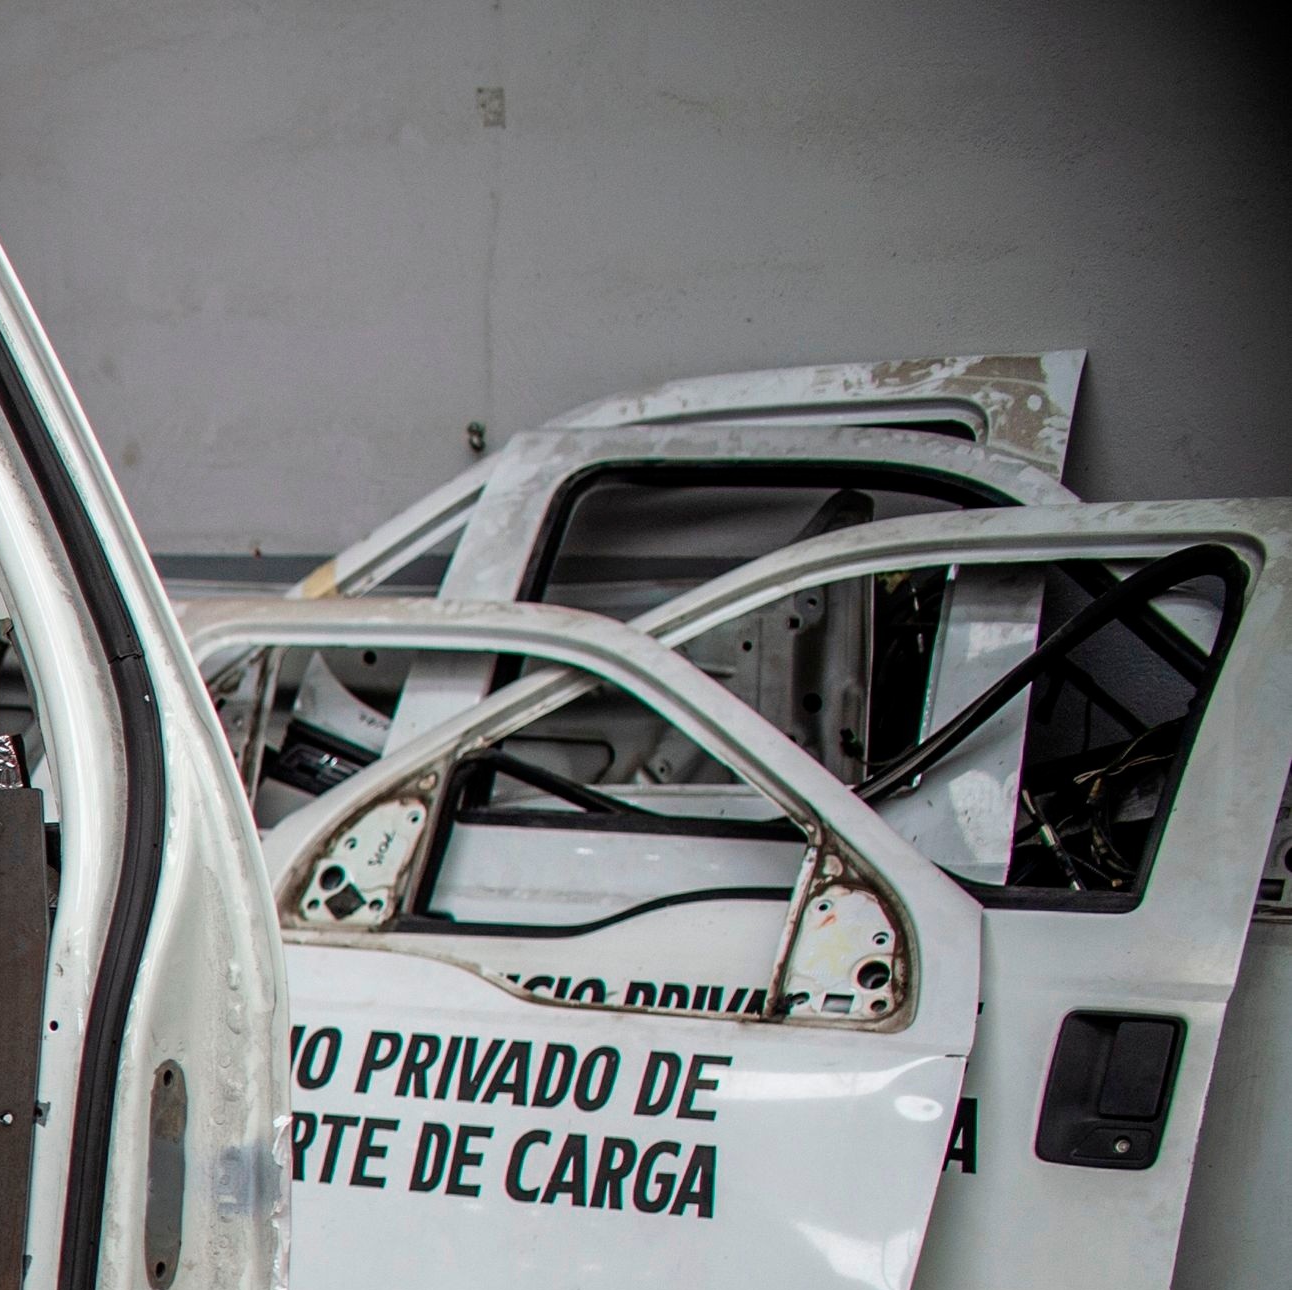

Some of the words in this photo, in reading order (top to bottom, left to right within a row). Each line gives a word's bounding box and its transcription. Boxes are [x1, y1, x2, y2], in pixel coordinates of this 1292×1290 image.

[354, 1029, 621, 1112] PRIVADO
[633, 1050, 733, 1121] DE
[408, 1121, 494, 1197] DE
[504, 1128, 717, 1218] CARGA
